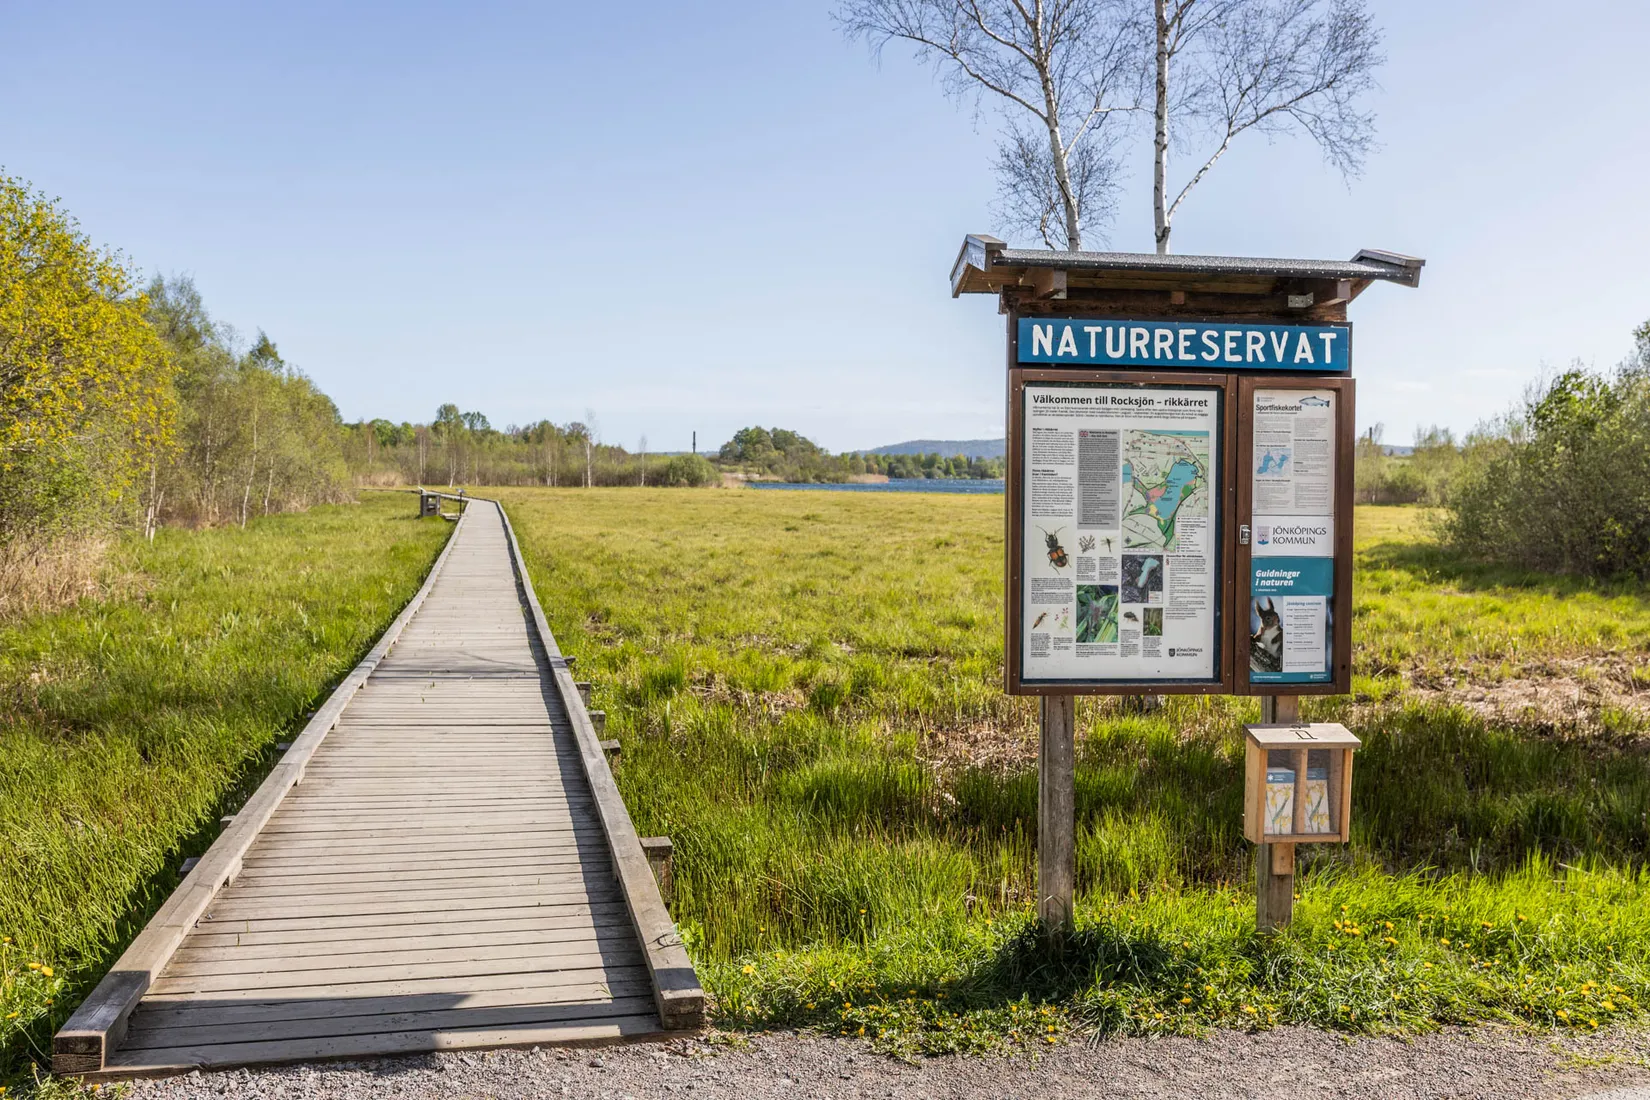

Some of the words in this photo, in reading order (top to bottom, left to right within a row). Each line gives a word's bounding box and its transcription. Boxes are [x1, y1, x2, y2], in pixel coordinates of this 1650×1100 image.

[1032, 324, 1337, 364] NATURRESERVAT
[1033, 395, 1092, 404] Välkommen
[1095, 396, 1108, 405] till
[1111, 396, 1154, 407] Rocksjön
[1164, 397, 1208, 407] rikkärret
[1256, 404, 1302, 412] Sportfiskekortet
[1272, 526, 1327, 535] JÖNKÖPINGS
[1255, 569, 1301, 579] Guidningar
[1255, 578, 1259, 586] i
